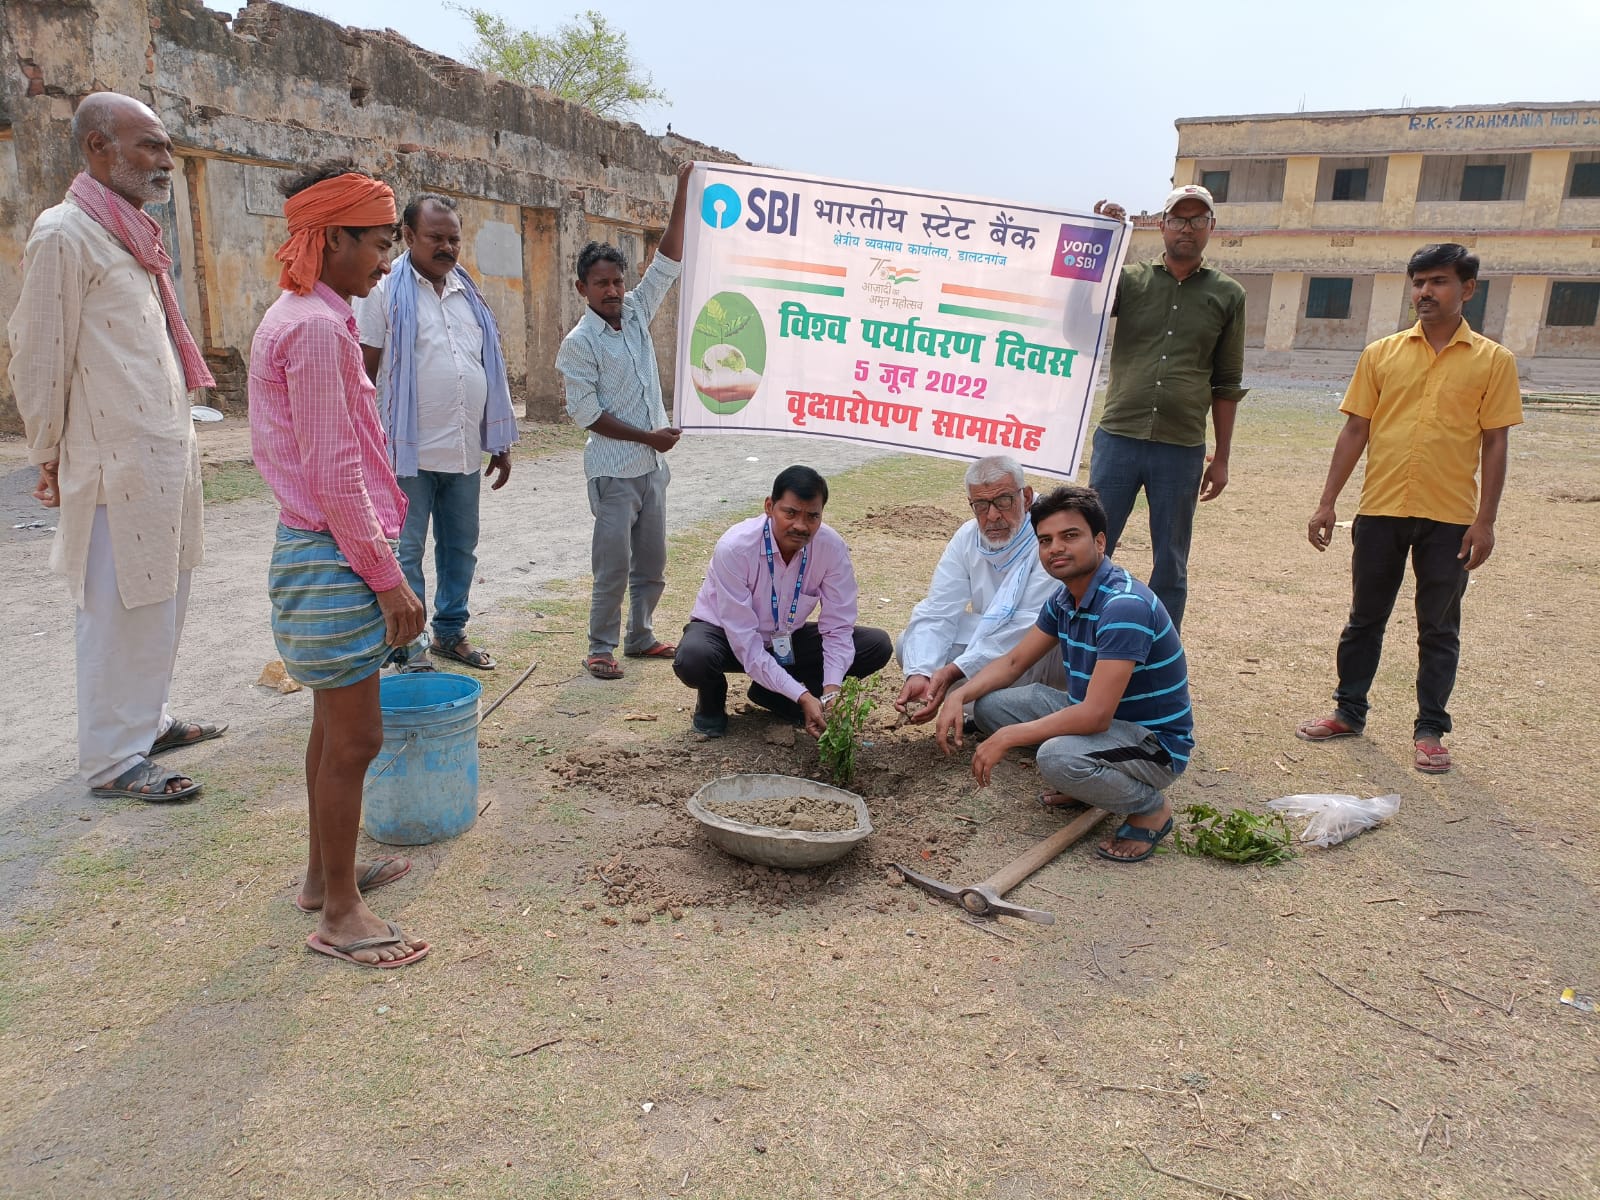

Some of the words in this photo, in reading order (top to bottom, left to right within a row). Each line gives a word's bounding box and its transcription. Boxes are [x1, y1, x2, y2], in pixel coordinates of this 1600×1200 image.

[746, 187, 800, 236] SBI
[814, 197, 908, 233] भारतीय
[921, 205, 976, 240] स्टेट
[989, 211, 1040, 250] बैंक
[833, 230, 860, 247] क्षेत्रीय
[865, 238, 903, 252] व्यवसाय
[958, 250, 1008, 266] डालटनगंज
[1061, 240, 1104, 255] yono
[1075, 256, 1096, 270] SBI
[892, 296, 924, 310] महोत्सव
[778, 301, 850, 343] विश्व
[861, 317, 986, 362] पर्यावरण
[995, 330, 1079, 378] दिवस
[855, 360, 870, 381] 5
[879, 363, 918, 394] जून
[925, 370, 988, 400] 2022
[785, 390, 922, 431] वृक्षारोपण
[931, 409, 1046, 451] सामारोह
